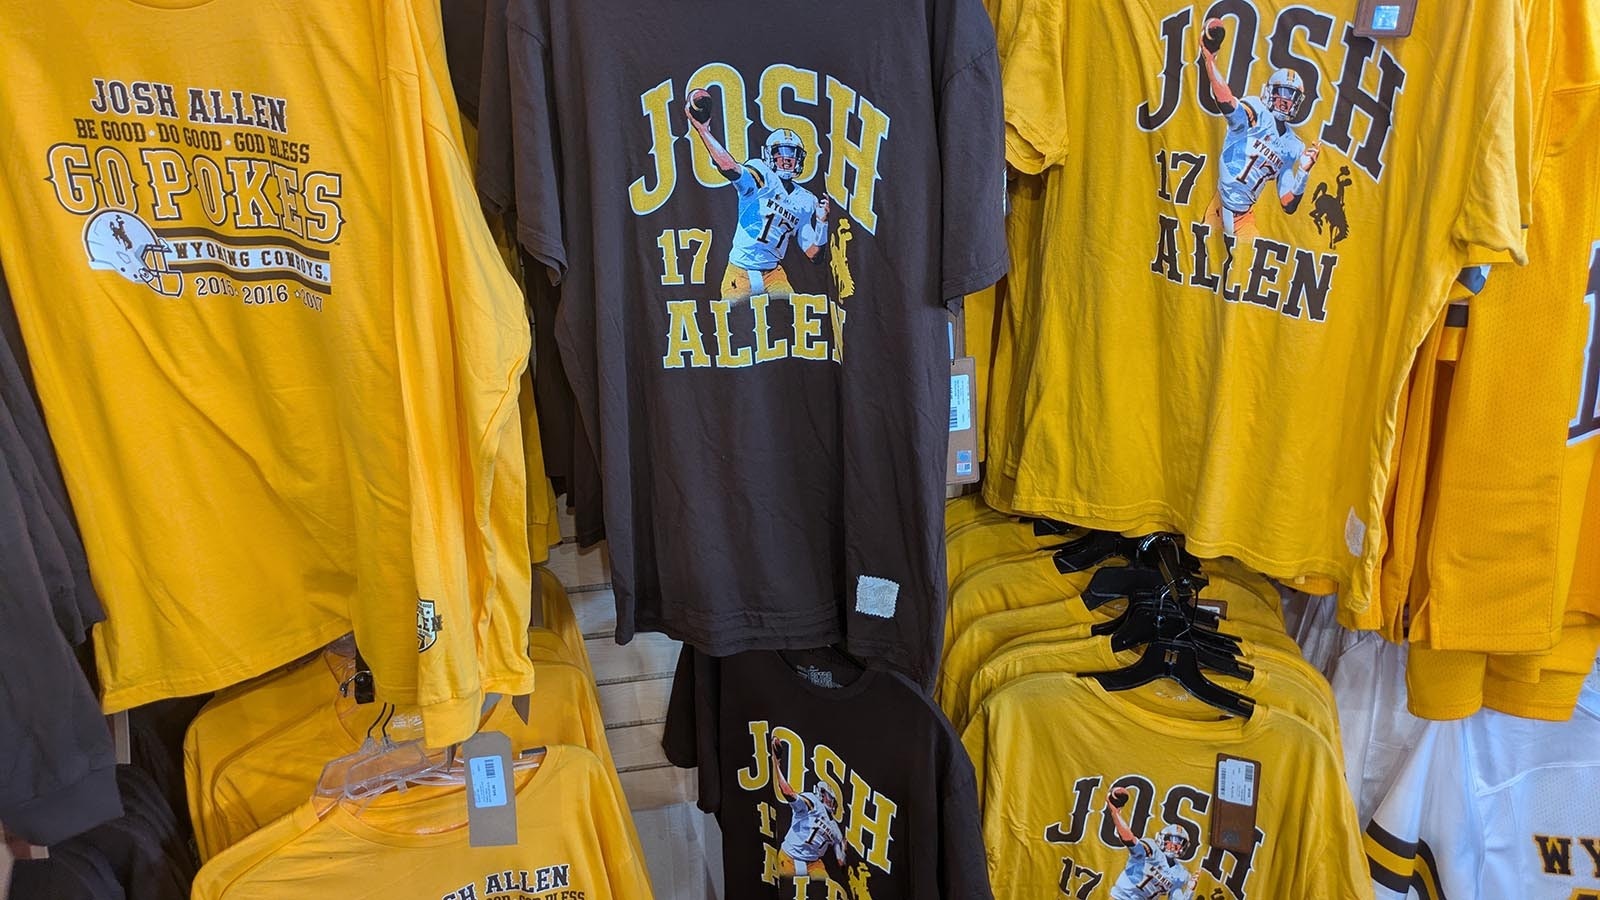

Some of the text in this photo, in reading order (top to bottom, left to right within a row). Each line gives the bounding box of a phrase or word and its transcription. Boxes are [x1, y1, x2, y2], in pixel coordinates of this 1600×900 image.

[90, 78, 287, 134] JOSH ALLEN
[1136, 0, 1407, 184] JOSH
[74, 118, 310, 164] BE GOOD DO GOOD GOD BLESS
[628, 62, 891, 236] JOSH
[45, 142, 346, 244] GO POKES
[1155, 149, 1207, 204] 17
[1236, 154, 1277, 193] 17
[757, 212, 795, 250] 17
[766, 198, 800, 226] WYOMING
[173, 241, 249, 267] WYOMING
[657, 228, 712, 285] 17
[1151, 213, 1338, 322] ALLEN
[195, 276, 235, 297] 2015
[242, 284, 289, 305] 2016
[663, 293, 846, 369] ALLEN
[737, 720, 897, 875] JOSH
[757, 801, 777, 838] 1
[485, 863, 570, 896] ALLEN
[1059, 856, 1103, 900] 17
